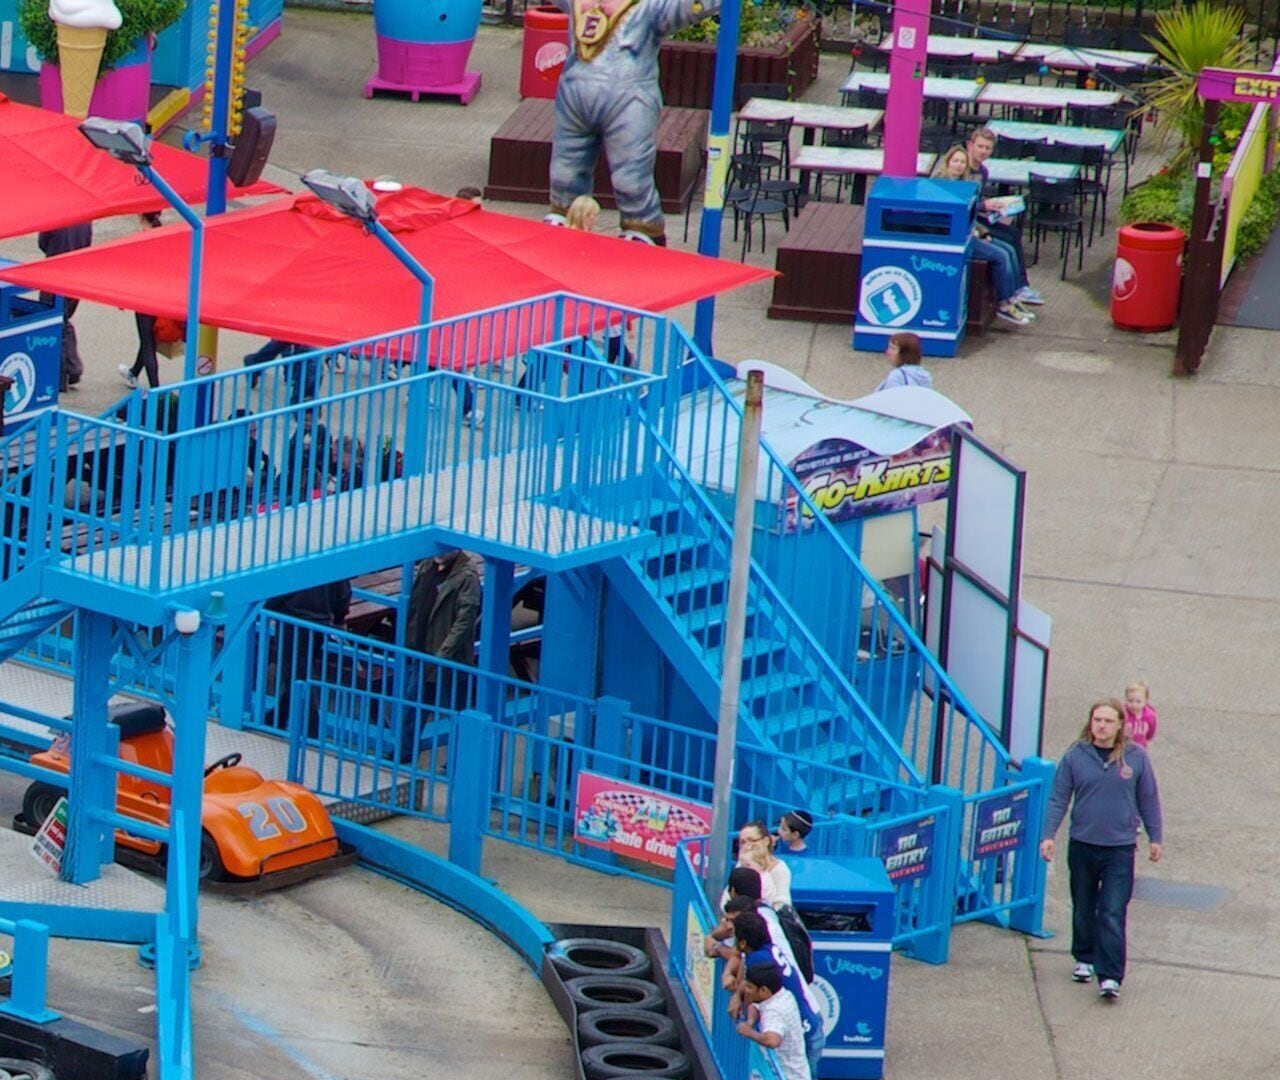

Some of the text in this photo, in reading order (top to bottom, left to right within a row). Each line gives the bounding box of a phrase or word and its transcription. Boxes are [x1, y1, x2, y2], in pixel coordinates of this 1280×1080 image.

[1235, 77, 1280, 98] EXIT
[236, 796, 307, 841] 20
[614, 829, 643, 849] safe
[980, 820, 1022, 845] ENTRY
[886, 846, 928, 870] ENTRY
